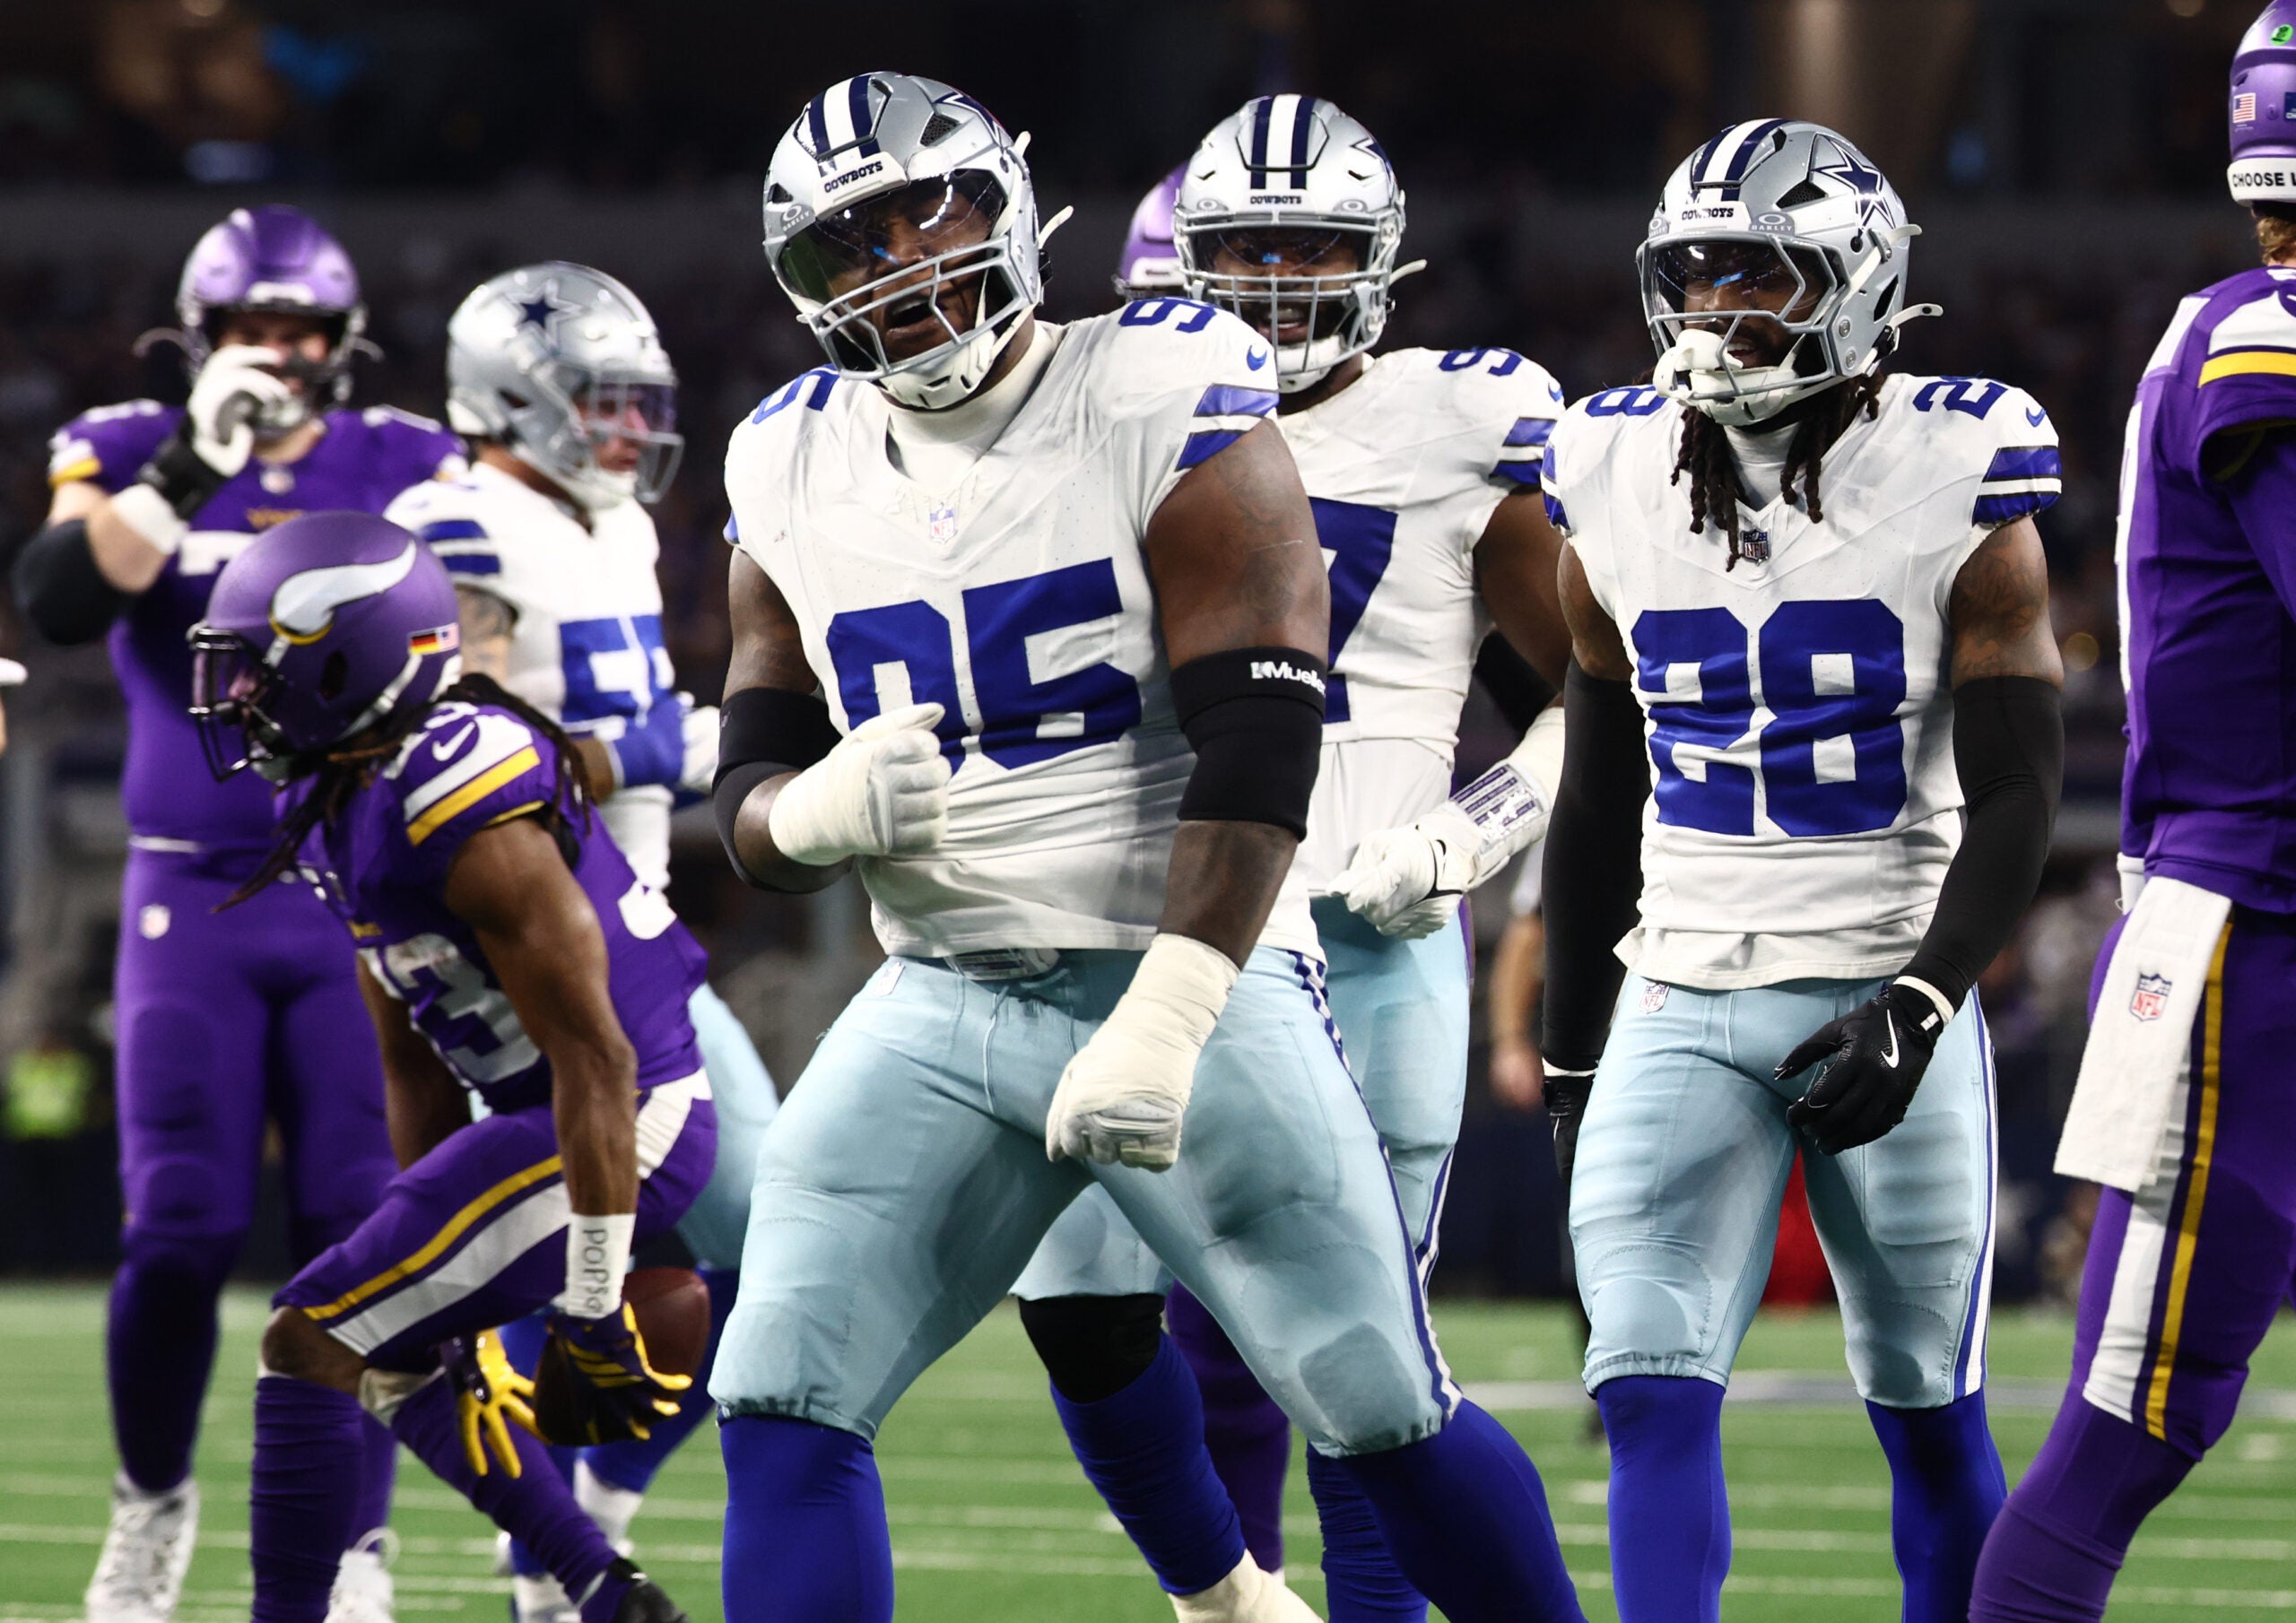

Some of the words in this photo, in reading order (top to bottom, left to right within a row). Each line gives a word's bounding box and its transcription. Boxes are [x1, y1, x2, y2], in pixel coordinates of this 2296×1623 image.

[824, 161, 883, 194] COWBOYS
[2232, 172, 2285, 187] CHOOSE
[1249, 195, 1302, 205] COWBOYS
[1751, 224, 1794, 232] OAKLEY
[1744, 542, 1767, 559] NFL
[1631, 598, 1908, 838] 28
[2133, 991, 2161, 1017] NFL
